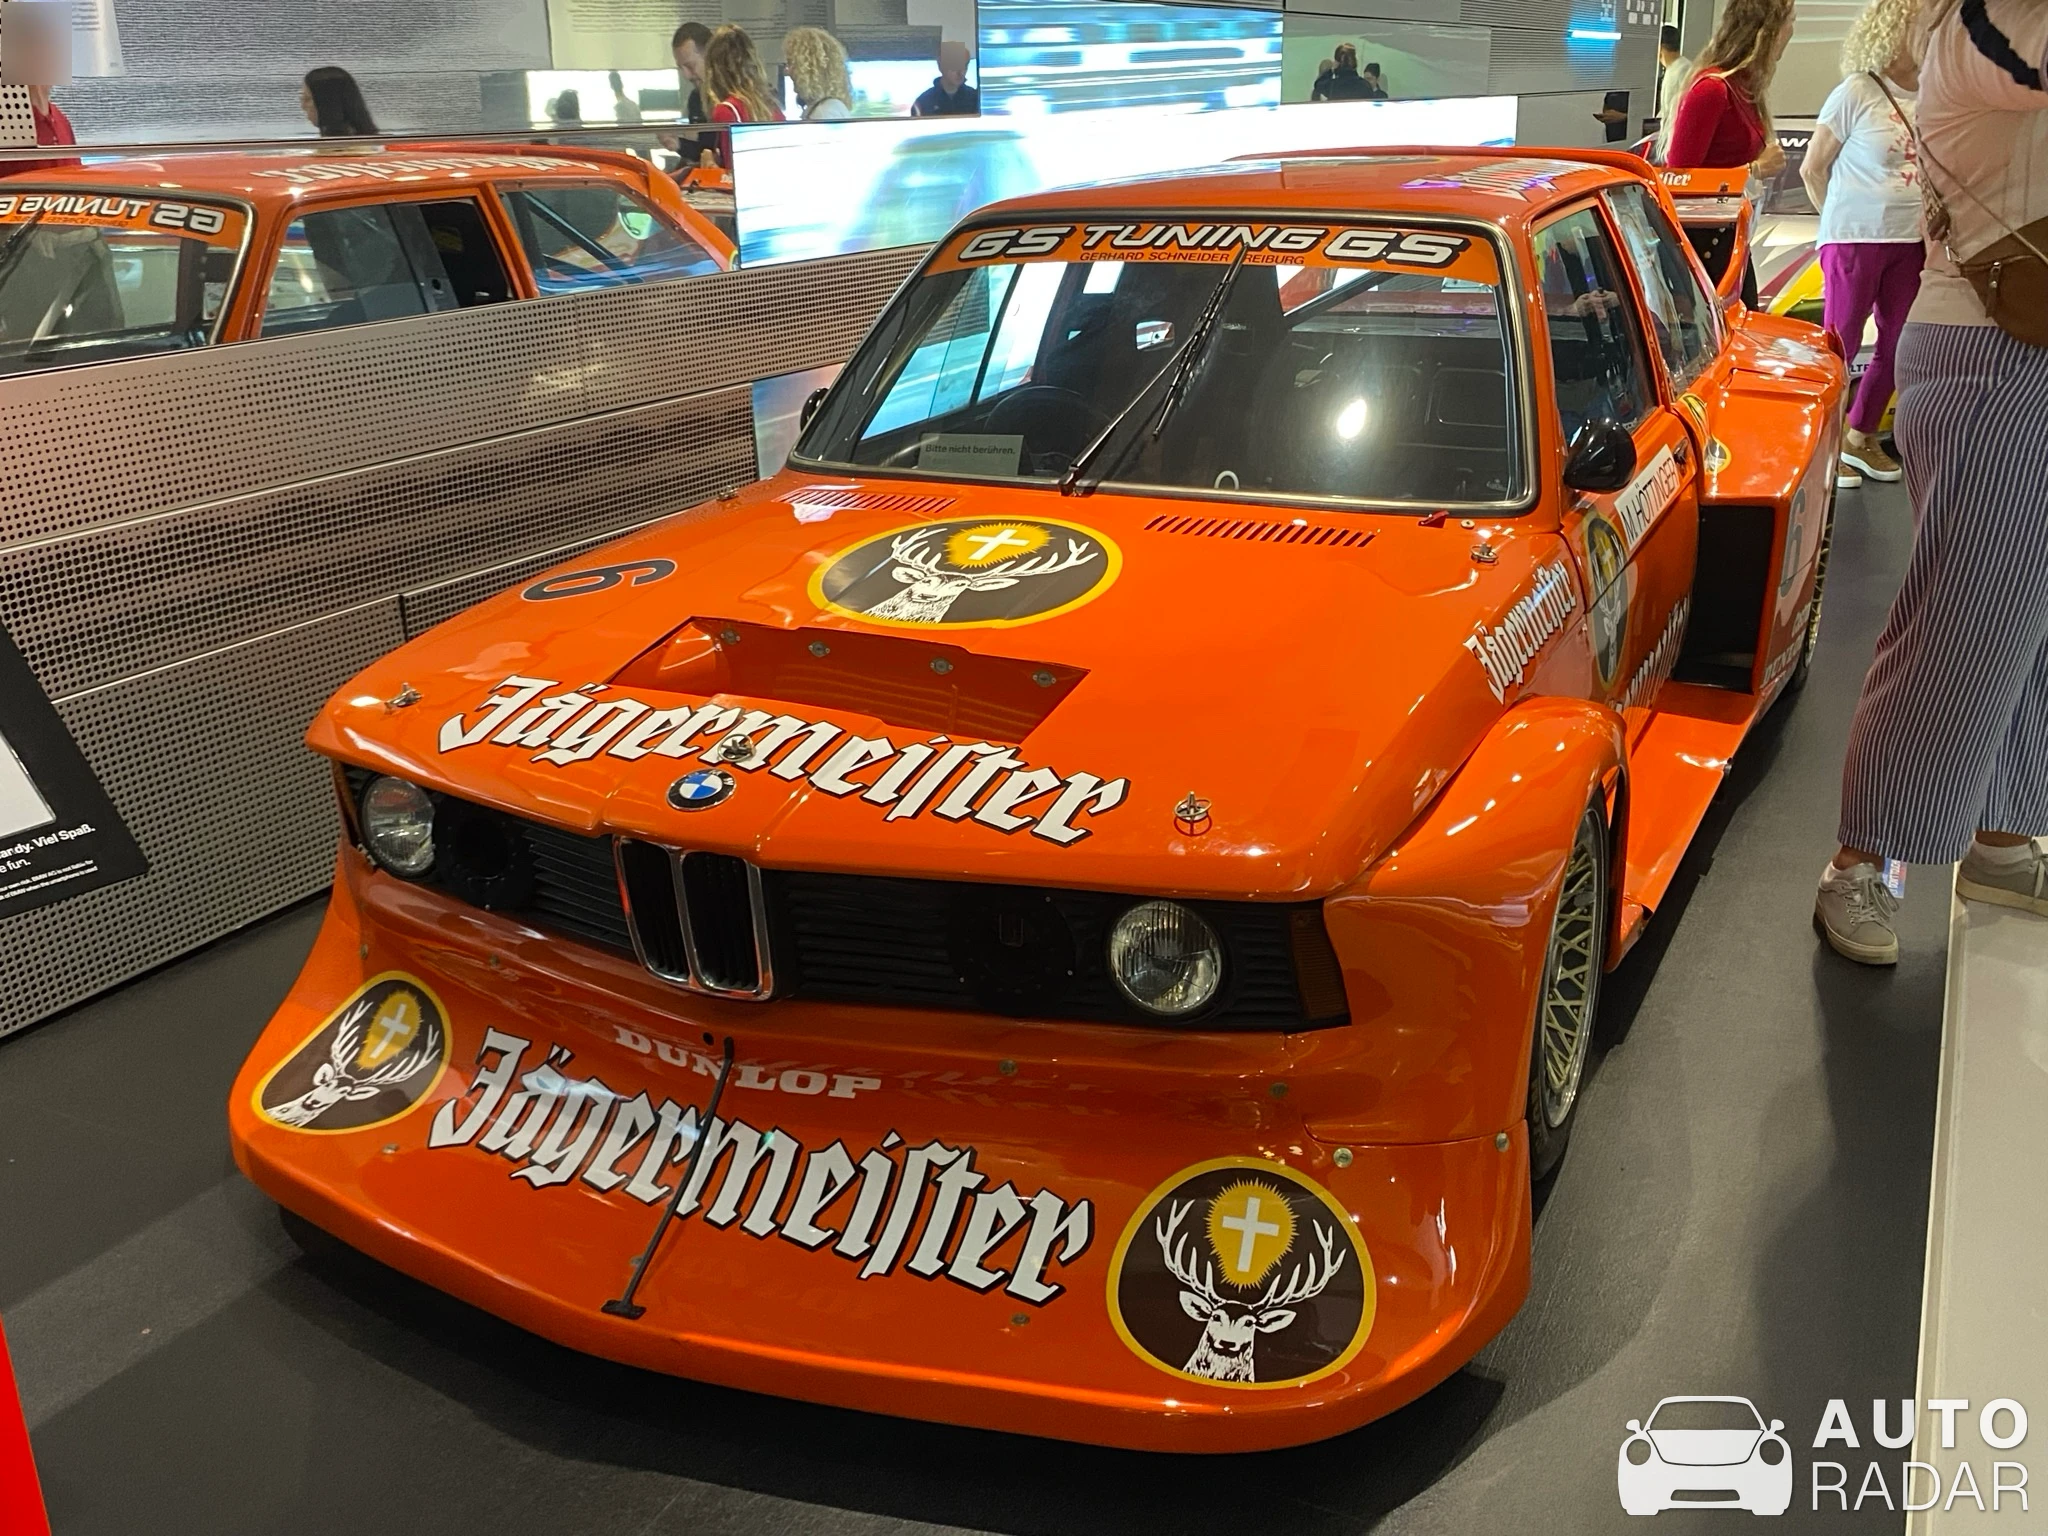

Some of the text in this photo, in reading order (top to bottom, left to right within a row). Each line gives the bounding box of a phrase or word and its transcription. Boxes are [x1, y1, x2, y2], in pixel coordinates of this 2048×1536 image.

[958, 223, 1472, 268] GS TUNING GS
[1079, 251, 1305, 265] GERHARD SCHNEIDER REIBURG
[925, 443, 1016, 455] Bitte nicht berühren.
[1779, 487, 1806, 600] 6
[520, 558, 679, 603] 6
[0, 824, 96, 857] andy. Viel Spaß.
[7, 859, 31, 870] fun.
[613, 1023, 883, 1101] DUNLOP
